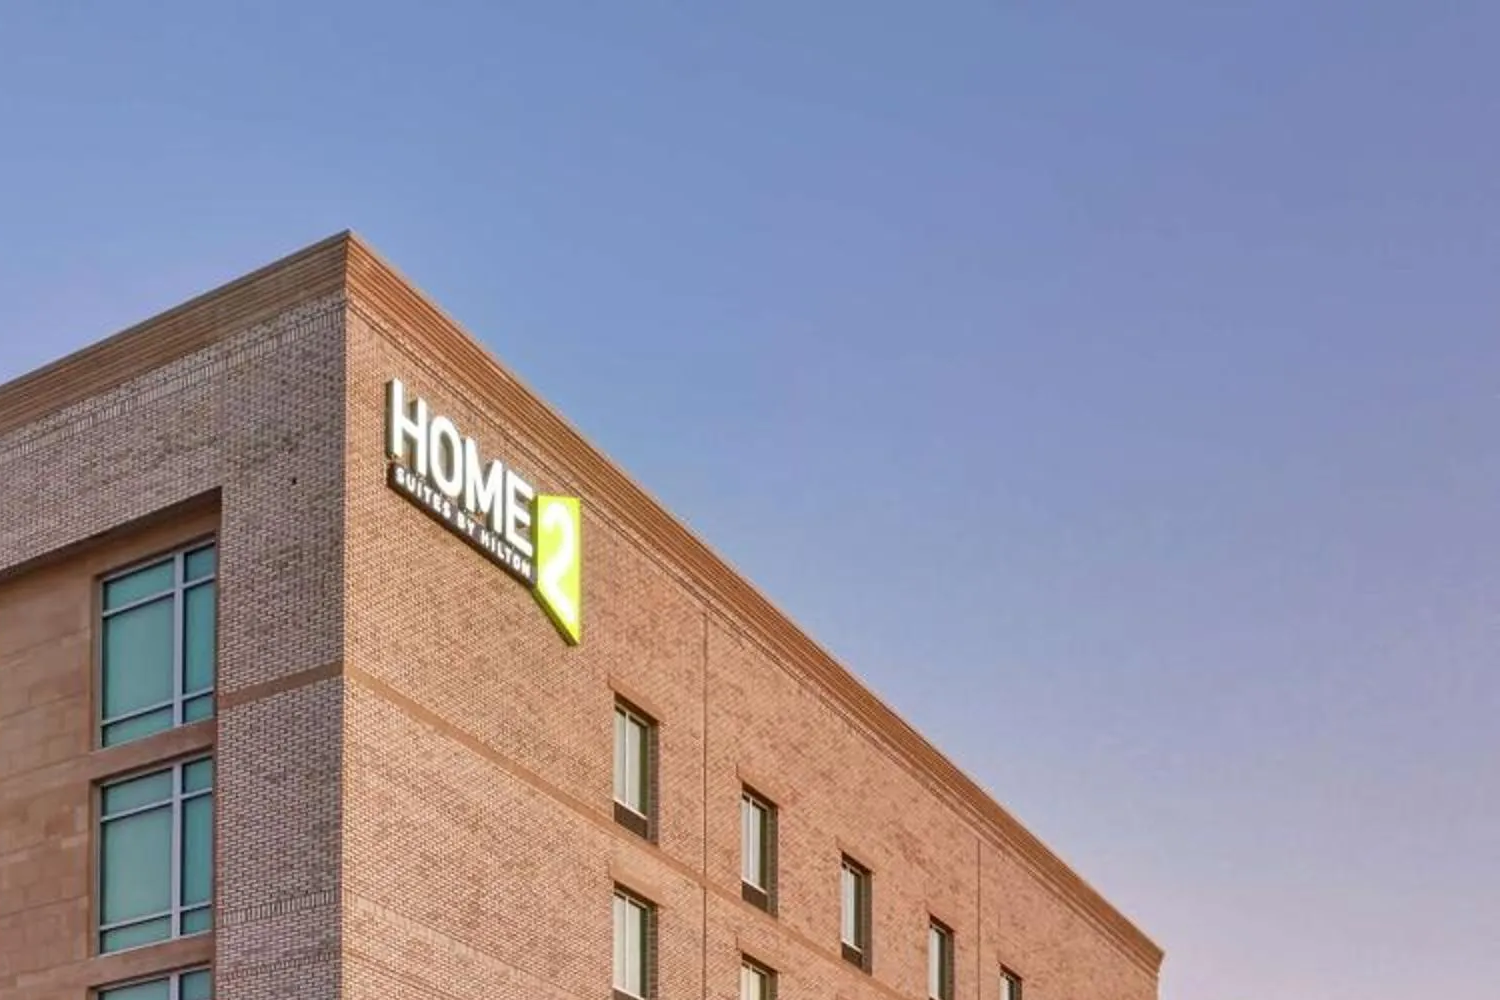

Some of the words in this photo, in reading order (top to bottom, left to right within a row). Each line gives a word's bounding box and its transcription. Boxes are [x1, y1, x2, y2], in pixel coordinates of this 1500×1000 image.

[392, 377, 533, 556] HOME
[540, 501, 575, 626] 2
[395, 466, 451, 519] SUITES
[456, 510, 475, 536] BY
[480, 528, 532, 578] HILTON
